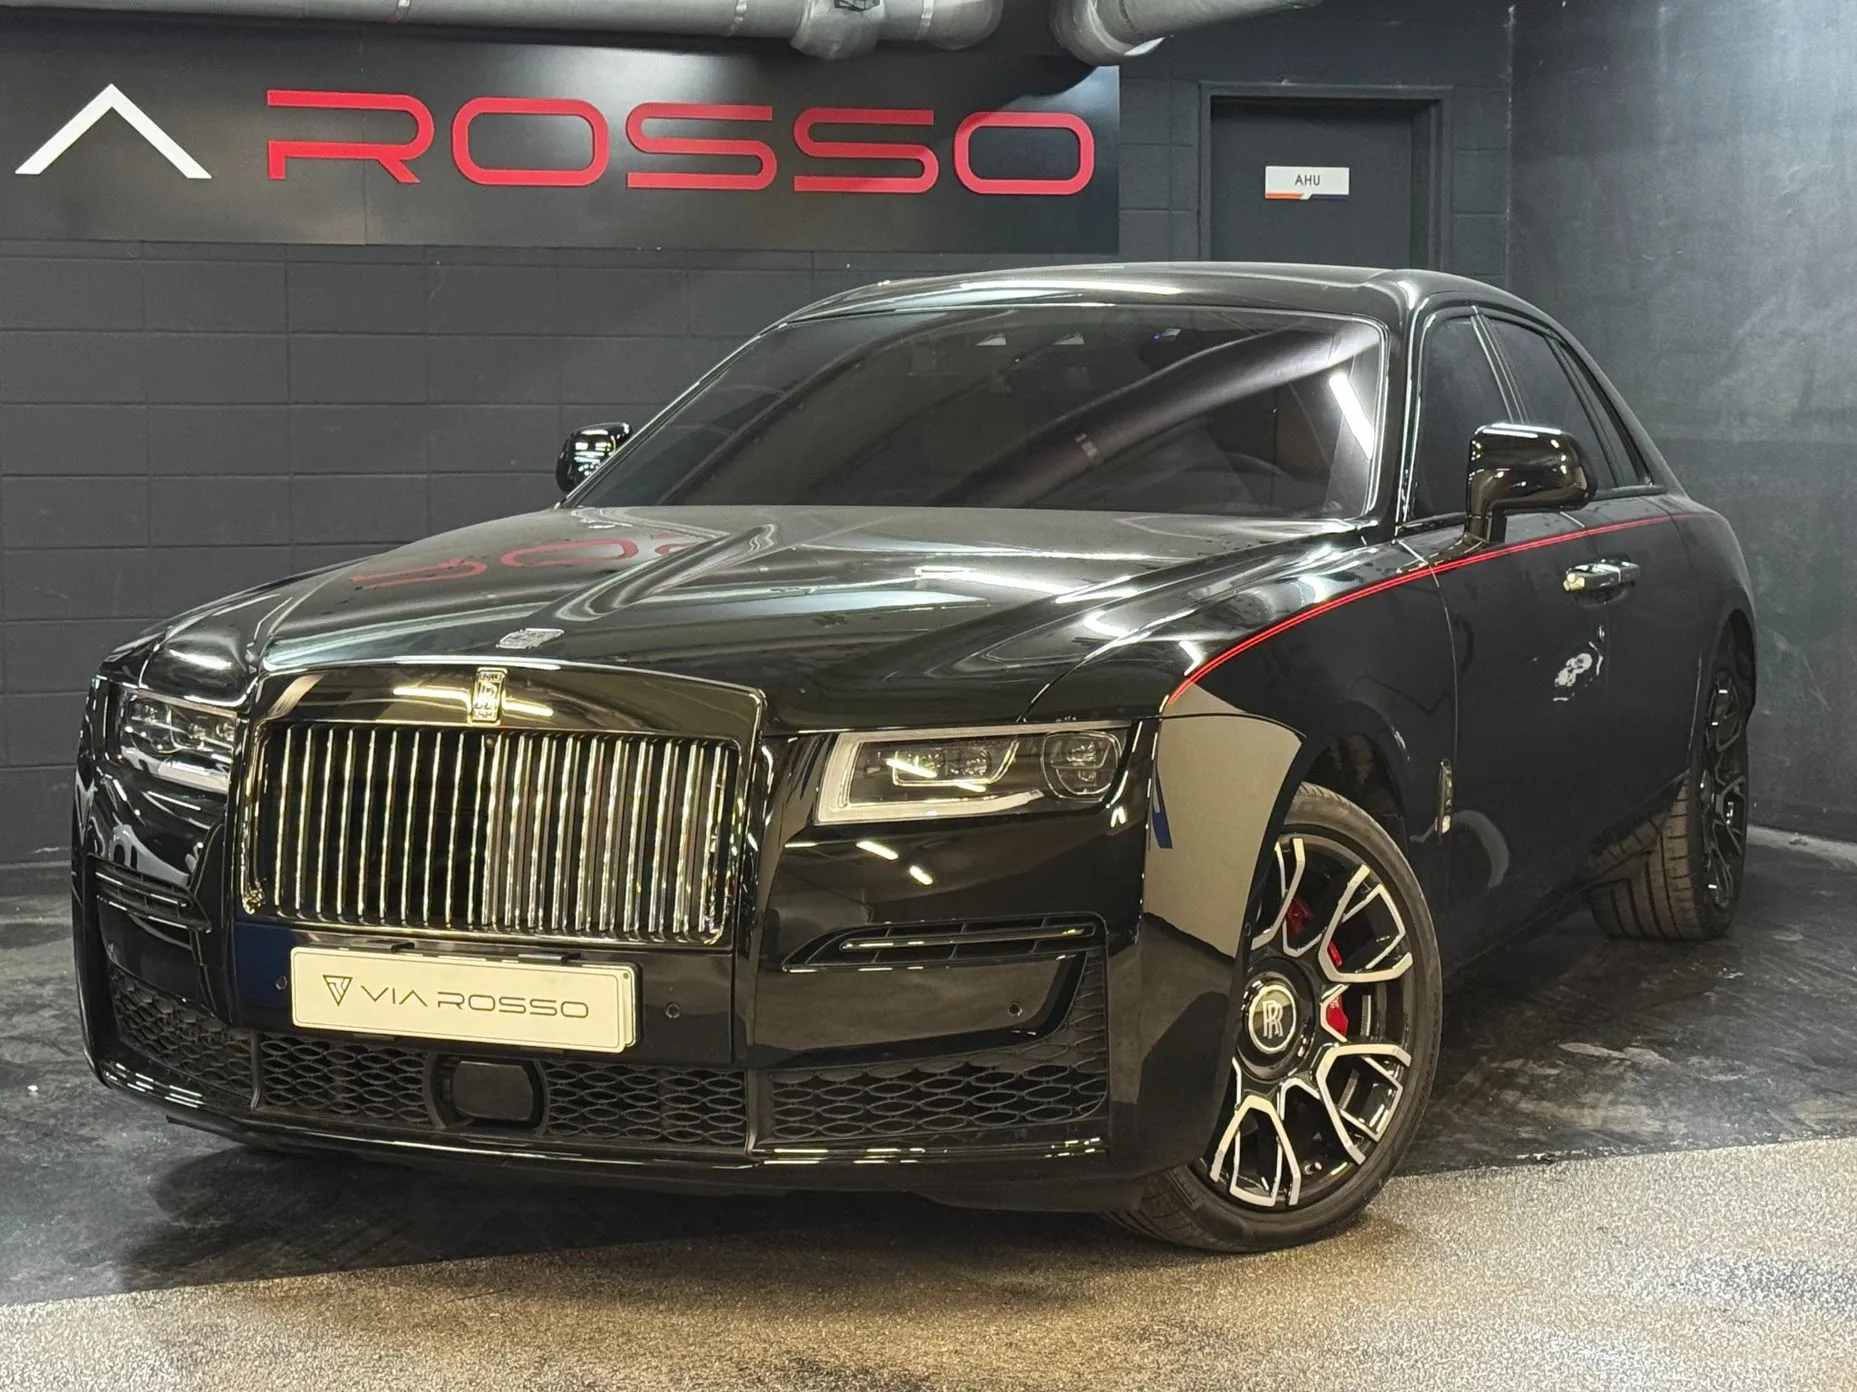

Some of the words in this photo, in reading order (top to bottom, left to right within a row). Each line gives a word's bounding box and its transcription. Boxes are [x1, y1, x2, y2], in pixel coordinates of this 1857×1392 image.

[267, 89, 1094, 195] ROSSO
[1295, 174, 1320, 186] AHU
[361, 985, 427, 1007] VIA
[437, 992, 588, 1018] ROSSO
